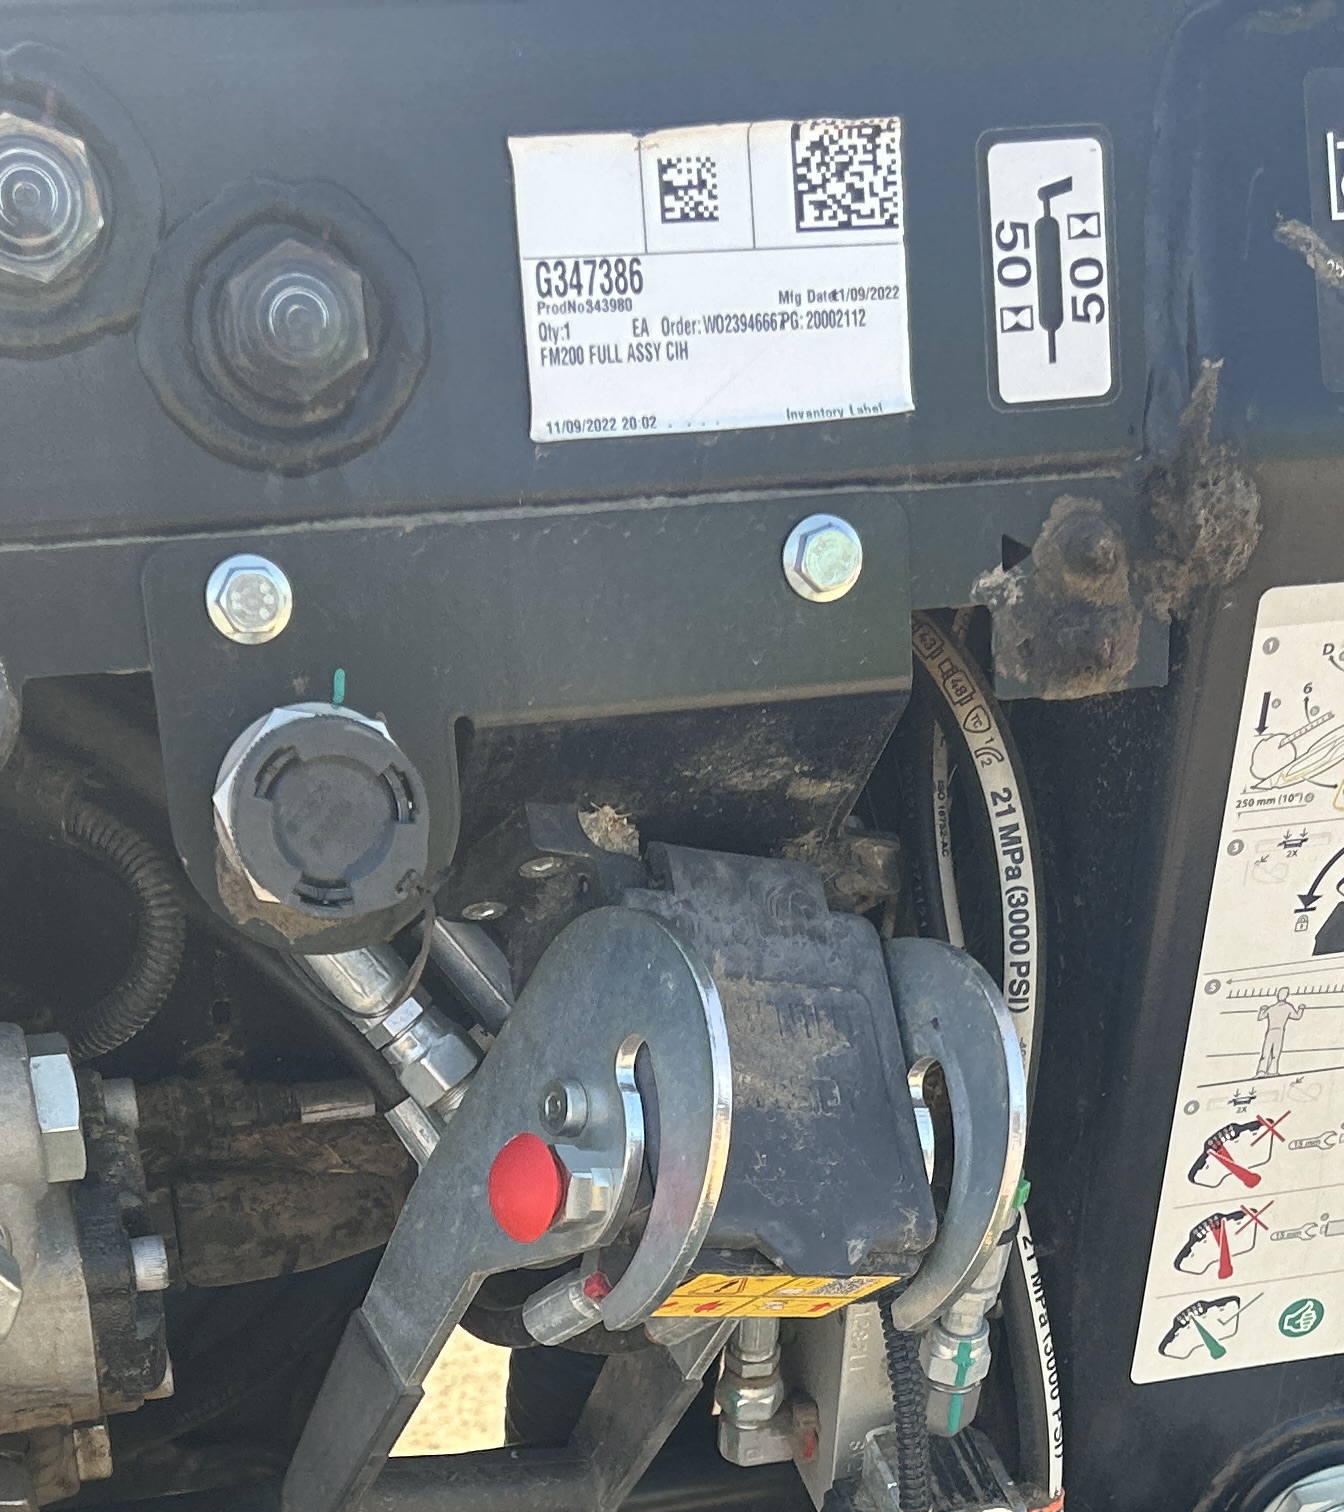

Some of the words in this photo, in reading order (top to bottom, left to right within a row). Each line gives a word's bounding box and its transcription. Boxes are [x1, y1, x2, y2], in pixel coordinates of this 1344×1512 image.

[995, 219, 1033, 290] 50
[535, 257, 644, 299] G347386
[1069, 256, 1106, 325] 50
[778, 290, 802, 307] Mfg
[632, 317, 650, 337] EA
[806, 308, 867, 330] 20002112
[541, 346, 585, 367] FM200
[589, 344, 623, 365] FULL
[627, 342, 662, 364] ASSY
[666, 341, 689, 361] CIH
[546, 417, 618, 435] 11/09/2022
[622, 414, 657, 431] 20:02
[786, 406, 844, 422] Inventory
[1322, 642, 1335, 656] D
[1303, 681, 1313, 694] 6
[989, 786, 1014, 820] 21
[1235, 798, 1255, 809] 250
[1256, 796, 1276, 806] mm
[997, 821, 1025, 882] MPa
[1003, 883, 1032, 956] (3000
[1007, 959, 1031, 1015] PSI)
